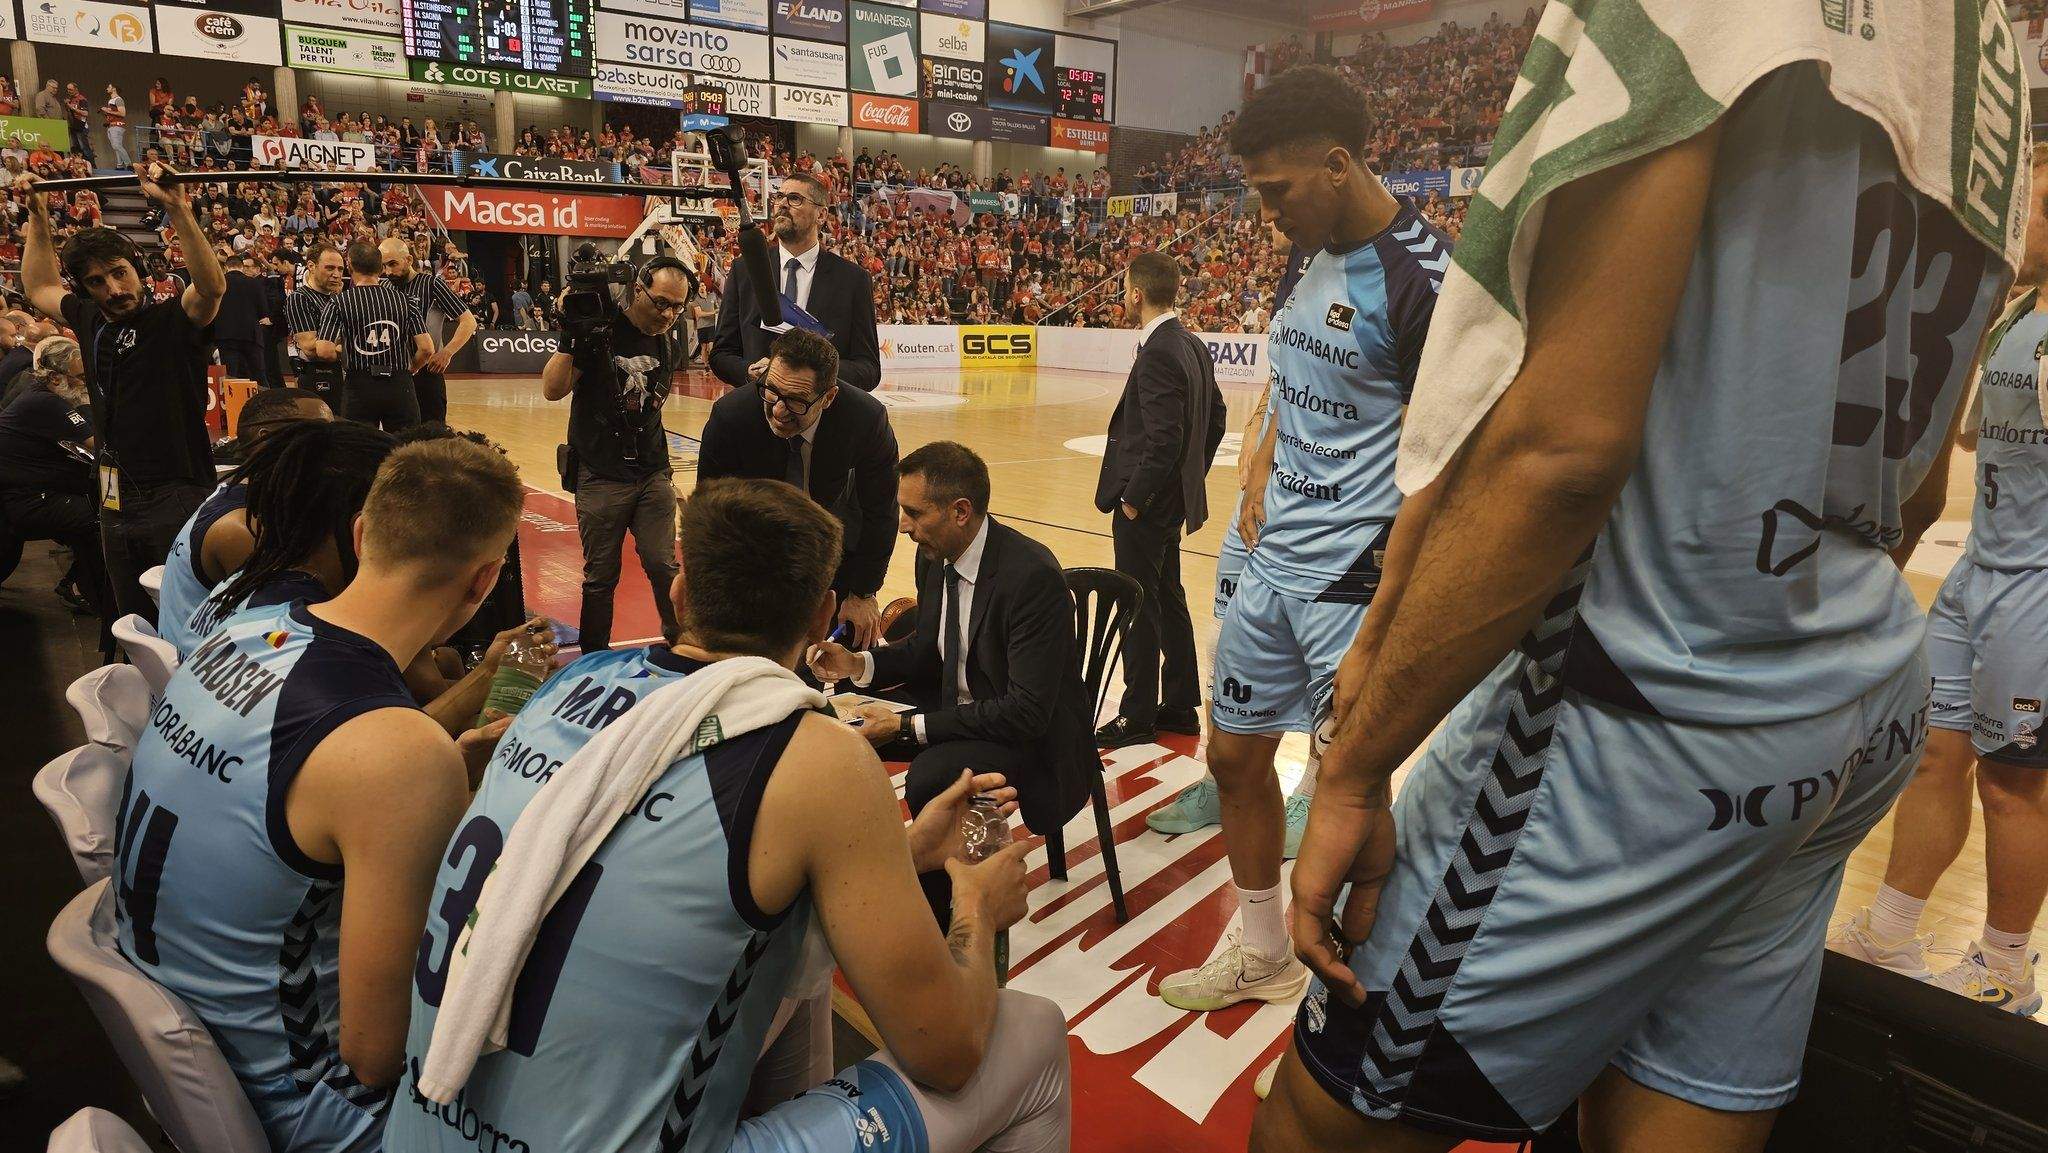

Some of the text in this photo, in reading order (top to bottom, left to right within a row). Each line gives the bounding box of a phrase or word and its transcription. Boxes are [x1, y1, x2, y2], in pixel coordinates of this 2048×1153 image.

[31, 14, 67, 26] OSTEO
[777, 2, 843, 23] EXLAND
[856, 9, 912, 29] UMANRESA
[32, 23, 67, 34] SPORT
[206, 16, 232, 27] café
[493, 20, 517, 37] 5:03
[204, 24, 236, 36] crem
[625, 21, 728, 51] movento
[299, 36, 347, 48] BUSQUEM
[939, 36, 968, 52] selba
[299, 45, 333, 56] TALENT
[371, 50, 396, 58] TALENT
[626, 43, 693, 68] sarsa
[791, 47, 844, 61] santasusana
[867, 44, 888, 59] FUB
[300, 54, 336, 65] PER TU!
[452, 67, 501, 85] COTS
[514, 74, 580, 94] CLARET
[1069, 69, 1094, 82] 05:03
[613, 94, 672, 107] www.b2b.studio
[784, 88, 833, 106] JOYSA
[937, 89, 978, 102] mini-casino
[1061, 89, 1072, 100] 72
[708, 102, 720, 114] 14
[729, 98, 760, 114] LOR
[860, 102, 910, 127] Coca-Cola
[1066, 128, 1108, 142] ESTRELLA
[289, 145, 365, 167] AIGNEP
[503, 160, 606, 183] CaixaBank
[1391, 182, 1419, 194] FEDAC
[444, 190, 578, 229] Macsa id
[1327, 317, 1350, 329] endesa
[366, 329, 390, 348] 44
[483, 331, 559, 354] endes
[962, 334, 1032, 355] GCS
[897, 343, 955, 354] Kouten.cat
[1207, 342, 1257, 365] BAXI
[1281, 325, 1359, 370] MORABANC
[1983, 370, 2038, 391] MORABA
[1279, 381, 1360, 421] Andorra
[1984, 463, 1999, 510] 5
[188, 628, 285, 719] MADSEN
[2014, 702, 2036, 712] acb
[867, 1106, 891, 1144] hummel
